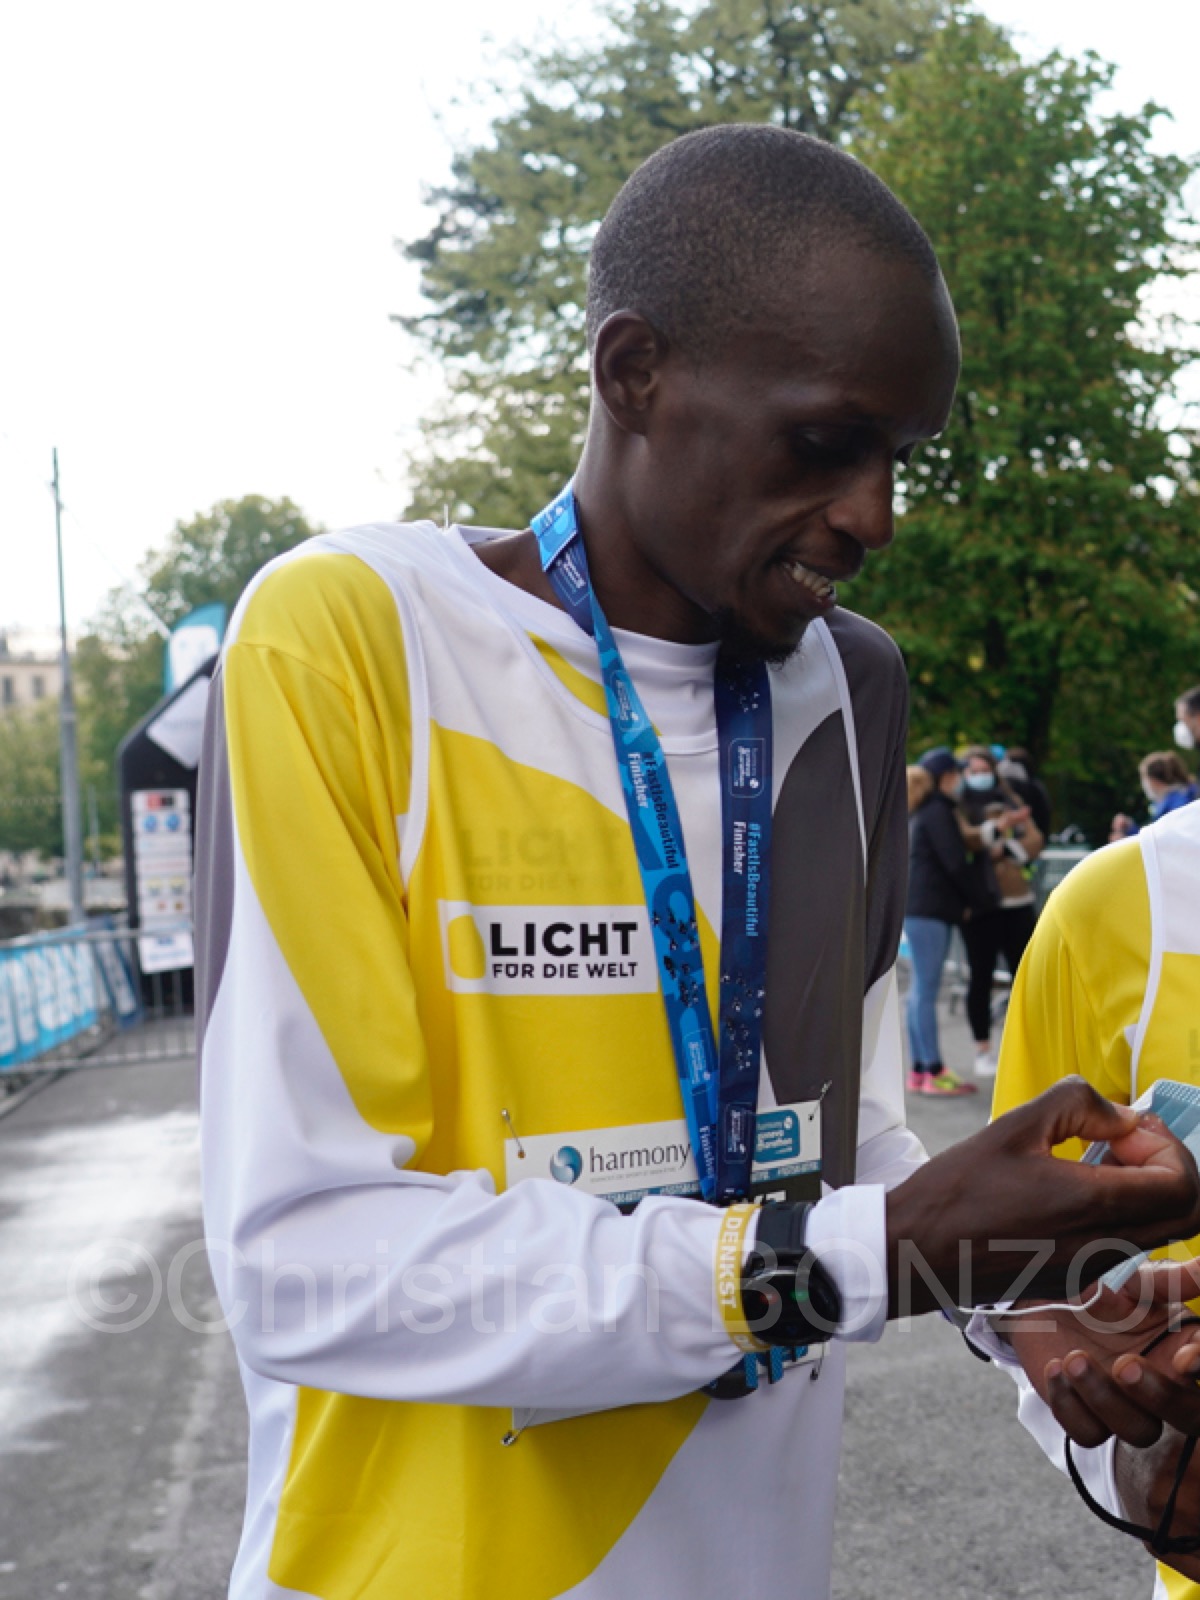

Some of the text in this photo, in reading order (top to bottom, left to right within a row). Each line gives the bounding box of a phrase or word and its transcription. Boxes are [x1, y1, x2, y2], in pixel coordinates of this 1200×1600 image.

[628, 752, 648, 808] Finisher
[733, 821, 747, 874] Finisher
[489, 922, 638, 957] LICHT
[492, 961, 639, 979] FÜR DIE WELT
[590, 1141, 692, 1173] harmony
[719, 1216, 744, 1309] DENKST
